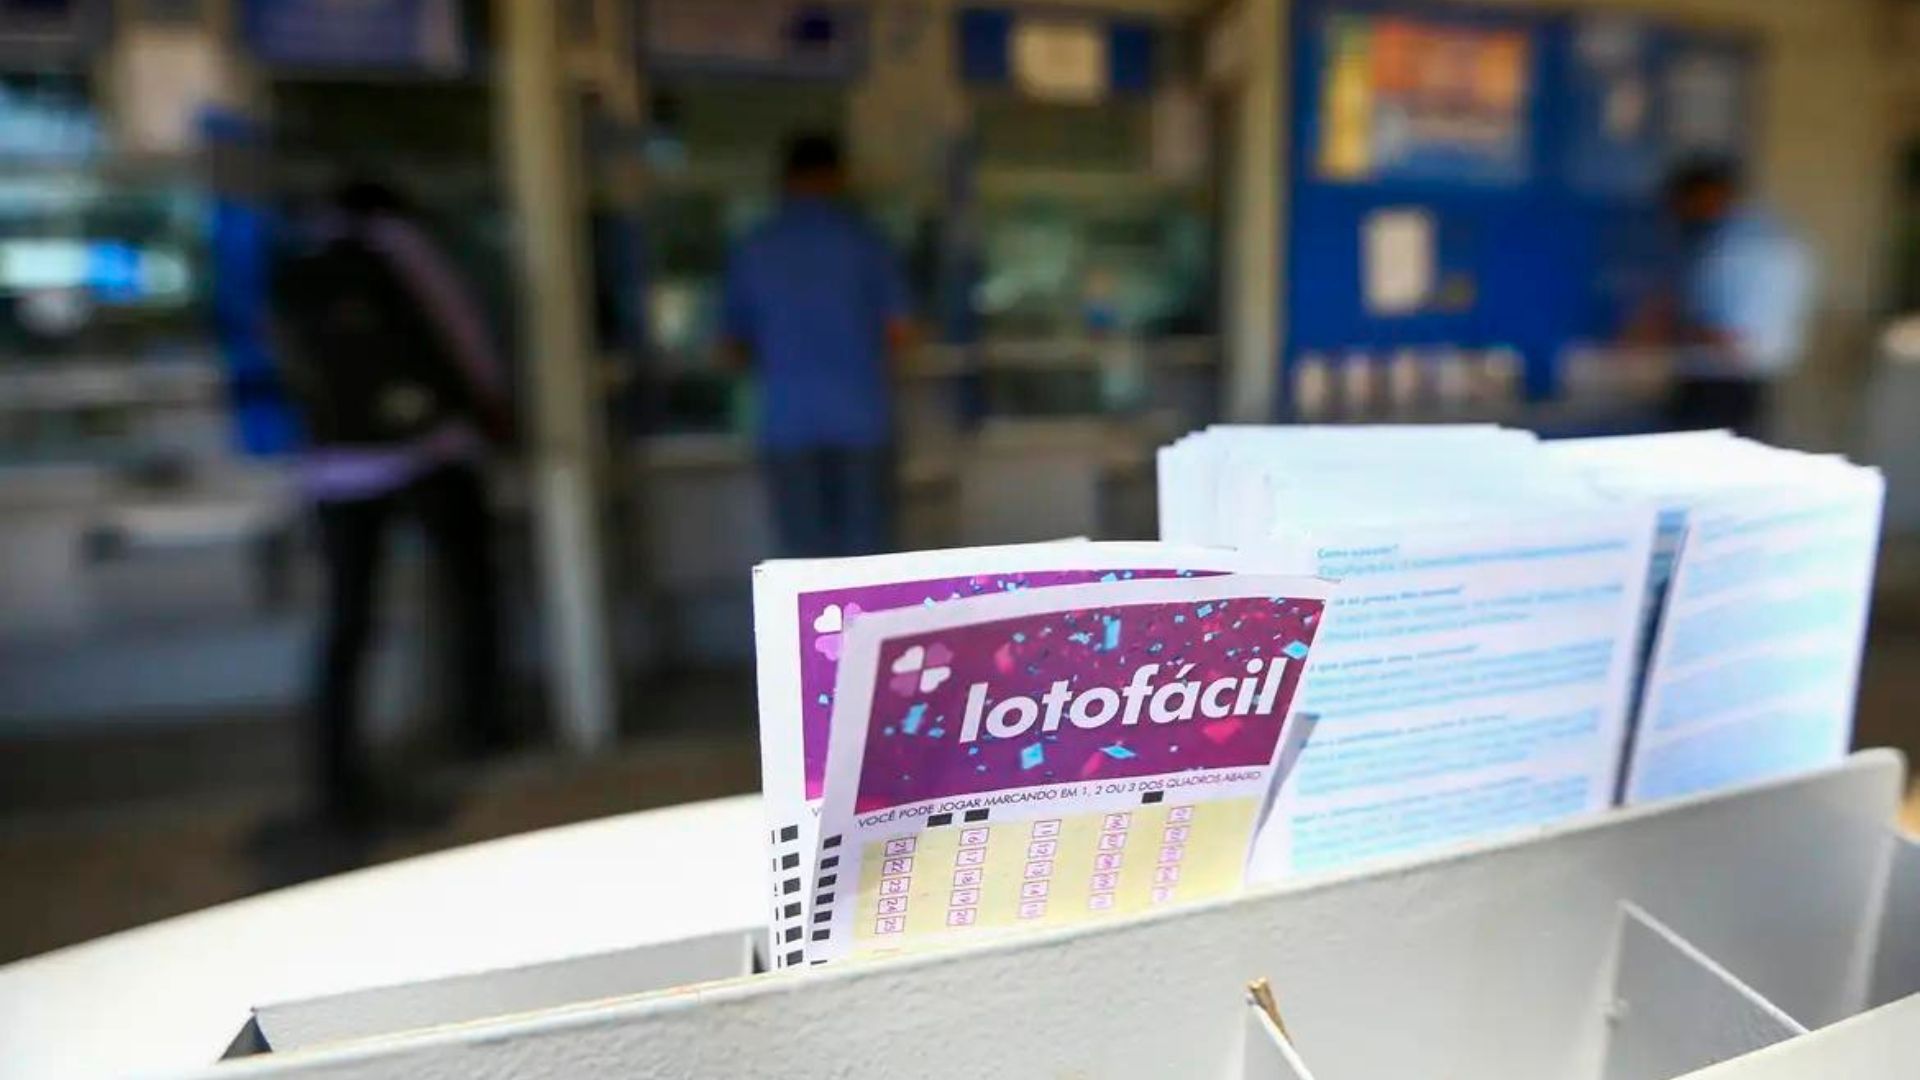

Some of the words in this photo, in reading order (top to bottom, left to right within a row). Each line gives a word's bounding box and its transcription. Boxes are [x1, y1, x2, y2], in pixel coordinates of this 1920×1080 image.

[959, 657, 1288, 744] lotofácil
[857, 810, 895, 828] VOCÊ
[899, 805, 934, 820] PODE
[937, 799, 982, 813] JOGAR
[984, 789, 1057, 807] MARCANDO
[1060, 788, 1078, 799] EM
[1094, 785, 1102, 795] 2
[1105, 783, 1125, 794] OU
[1128, 782, 1136, 792] 3
[1138, 780, 1164, 791] DOS
[1166, 774, 1221, 789] QUADROS
